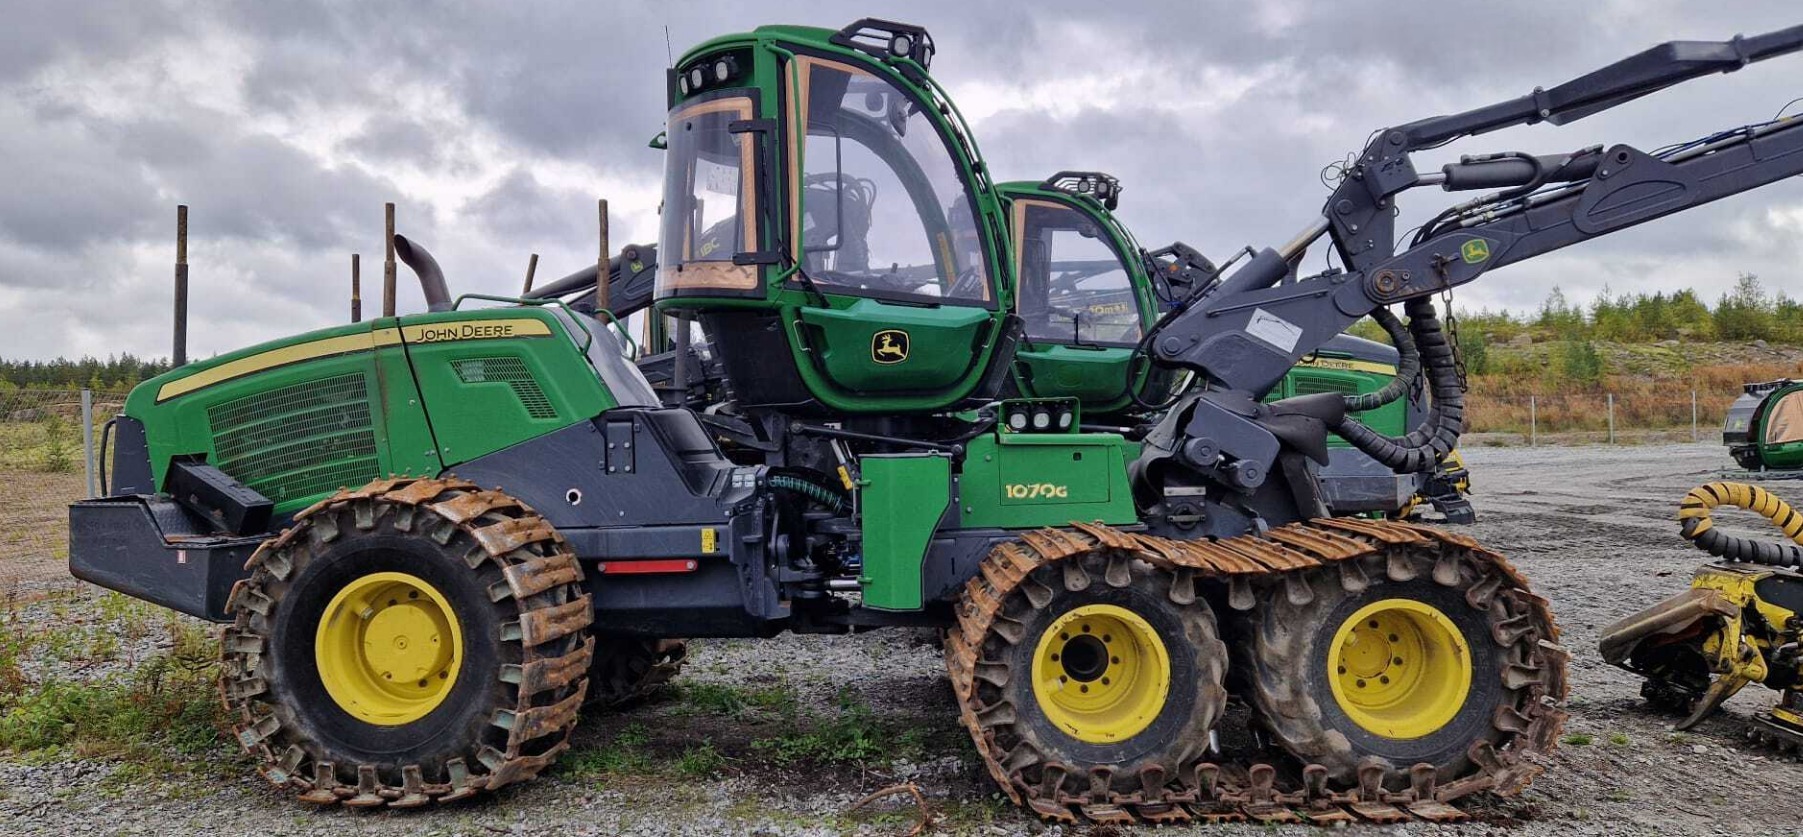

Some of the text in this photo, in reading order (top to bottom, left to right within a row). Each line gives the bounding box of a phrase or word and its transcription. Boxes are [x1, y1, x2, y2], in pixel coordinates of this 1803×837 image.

[417, 325, 513, 341] JOHN DEERE
[1005, 483, 1068, 499] 1070G
